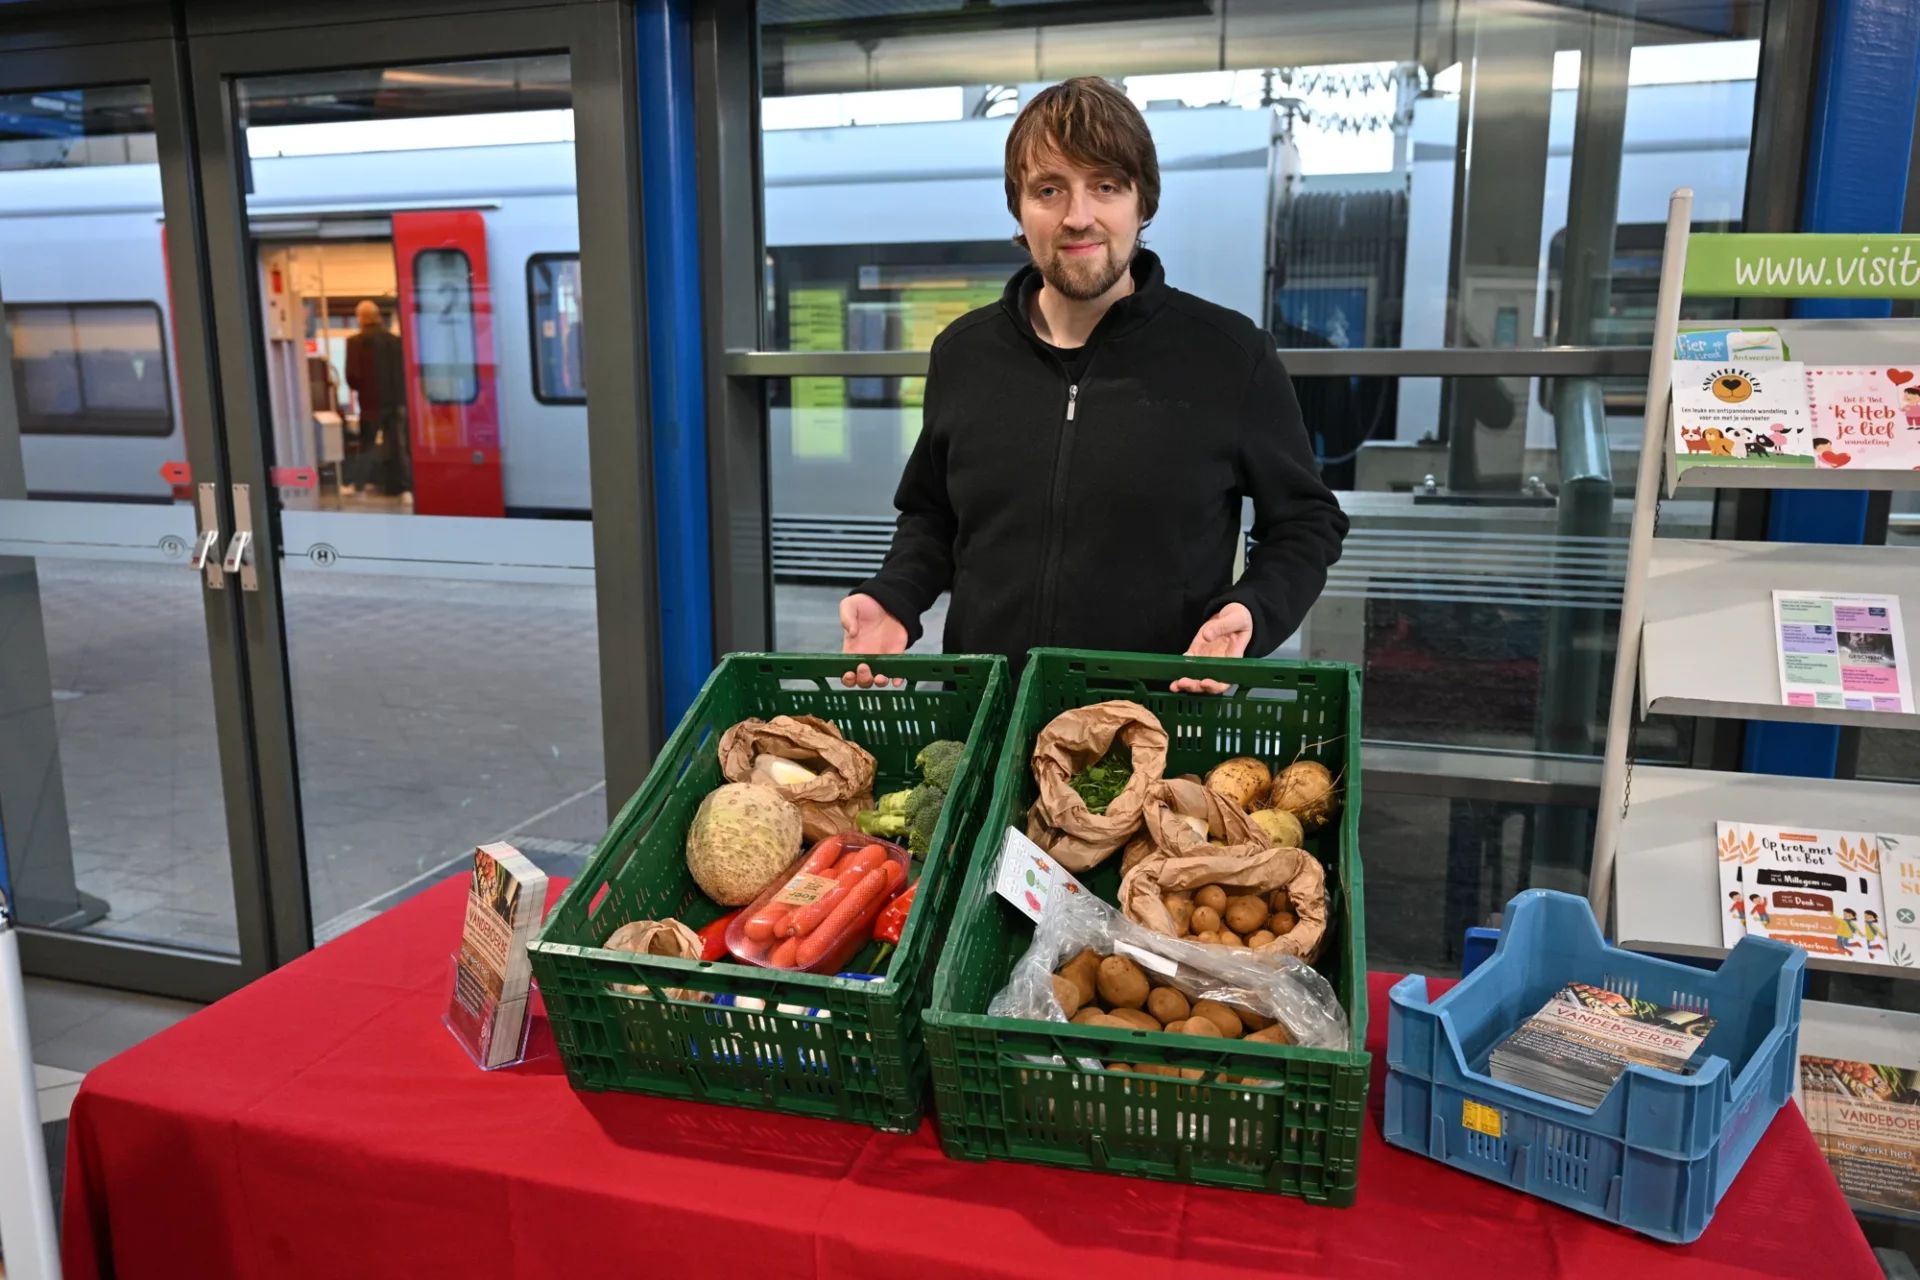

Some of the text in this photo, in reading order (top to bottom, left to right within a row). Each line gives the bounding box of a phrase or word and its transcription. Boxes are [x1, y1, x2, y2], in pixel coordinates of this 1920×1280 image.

[1852, 405, 1895, 420] Heb
[1836, 421, 1894, 440] je lief
[1762, 838, 1833, 855] Op trot met
[1775, 850, 1793, 862] Lot
[1804, 852, 1824, 865] Bot
[1784, 875, 1820, 887] Millegem
[1557, 1008, 1686, 1047] VANDEBOER.BE
[1562, 1030, 1596, 1043] werkt
[1837, 1141, 1912, 1160] Hoe werkt het?
